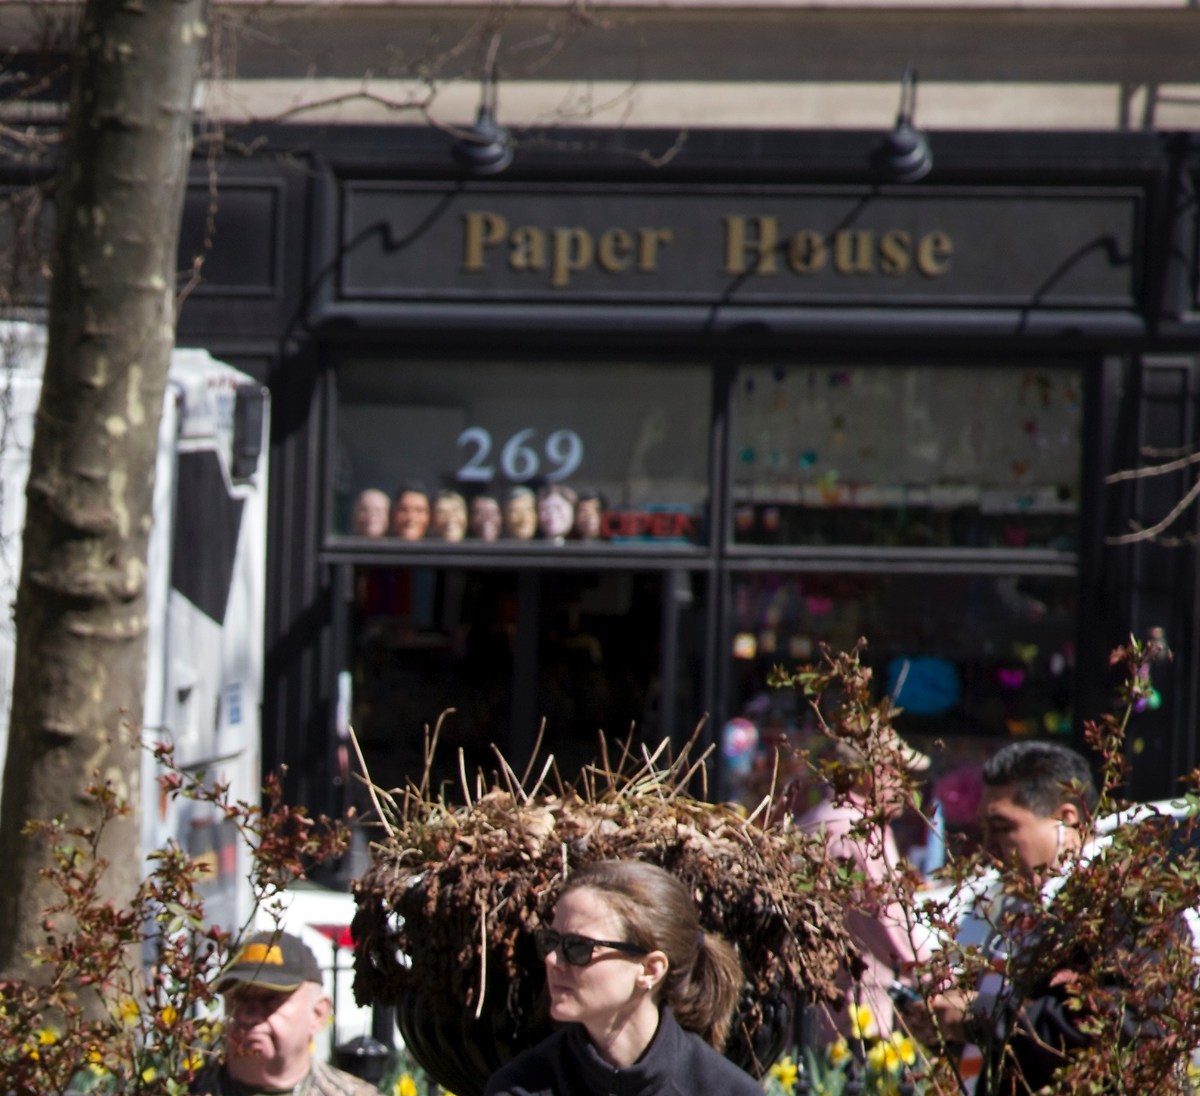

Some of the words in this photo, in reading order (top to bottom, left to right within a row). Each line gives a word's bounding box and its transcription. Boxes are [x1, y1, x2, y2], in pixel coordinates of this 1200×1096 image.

[464, 210, 673, 288] Paper
[724, 214, 954, 277] House
[456, 425, 584, 483] 269
